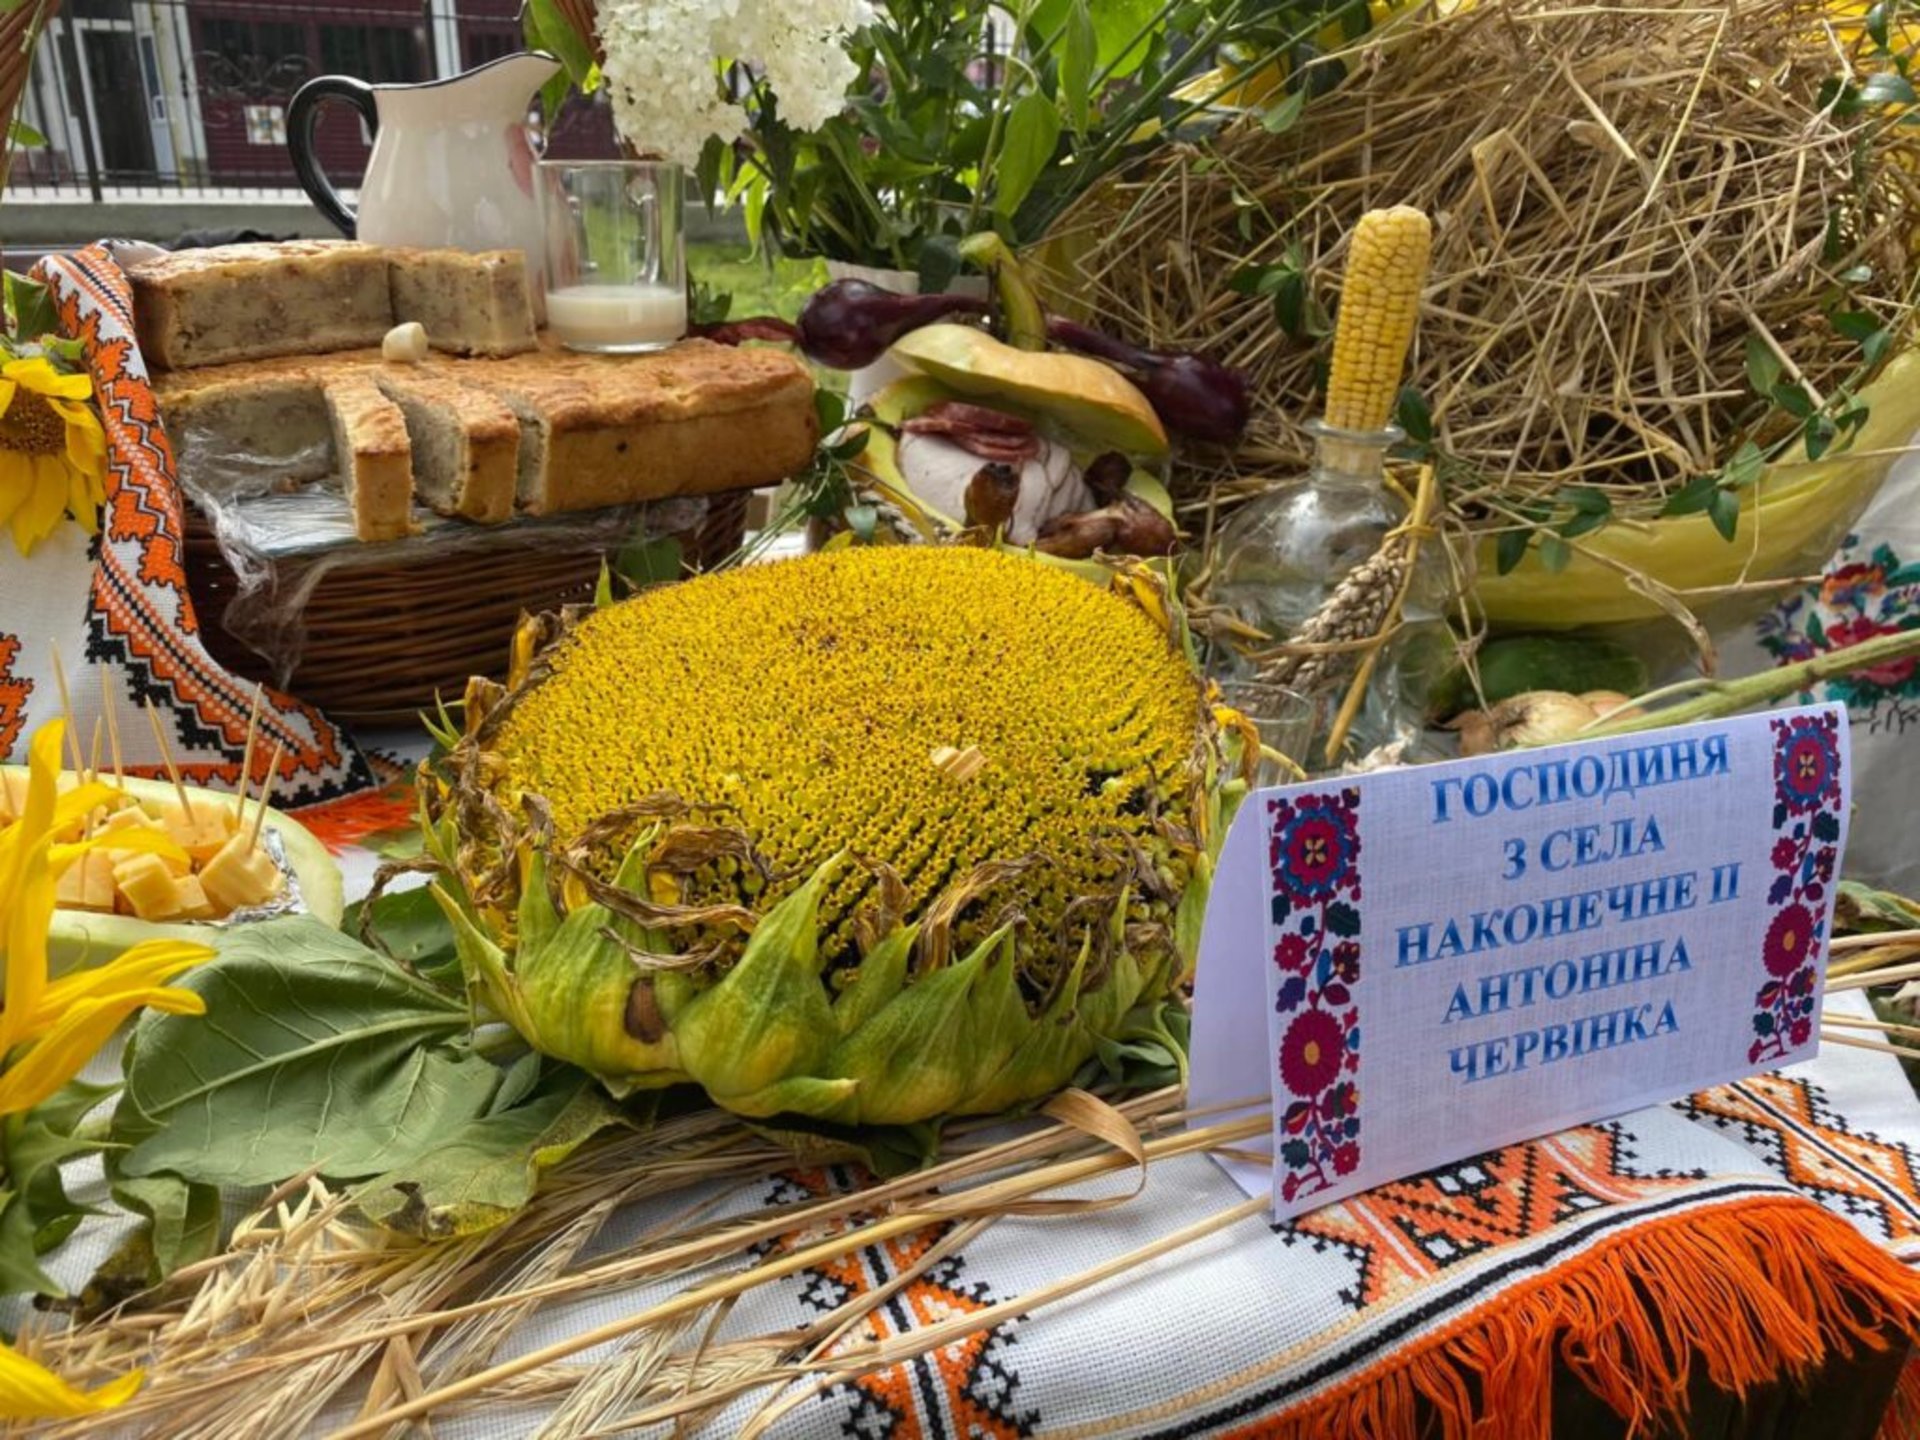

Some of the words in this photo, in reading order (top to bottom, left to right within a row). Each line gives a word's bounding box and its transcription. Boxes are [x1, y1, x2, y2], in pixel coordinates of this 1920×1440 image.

[1431, 733, 1730, 824] ГОСПОДИНЯ
[1538, 813, 1667, 875] СЕЛА
[1394, 871, 1699, 968] НАКОНЕЧНЕ
[1440, 935, 1693, 1025] АНТОНІНА
[1447, 999, 1680, 1084] ЧЕРВІНКА
